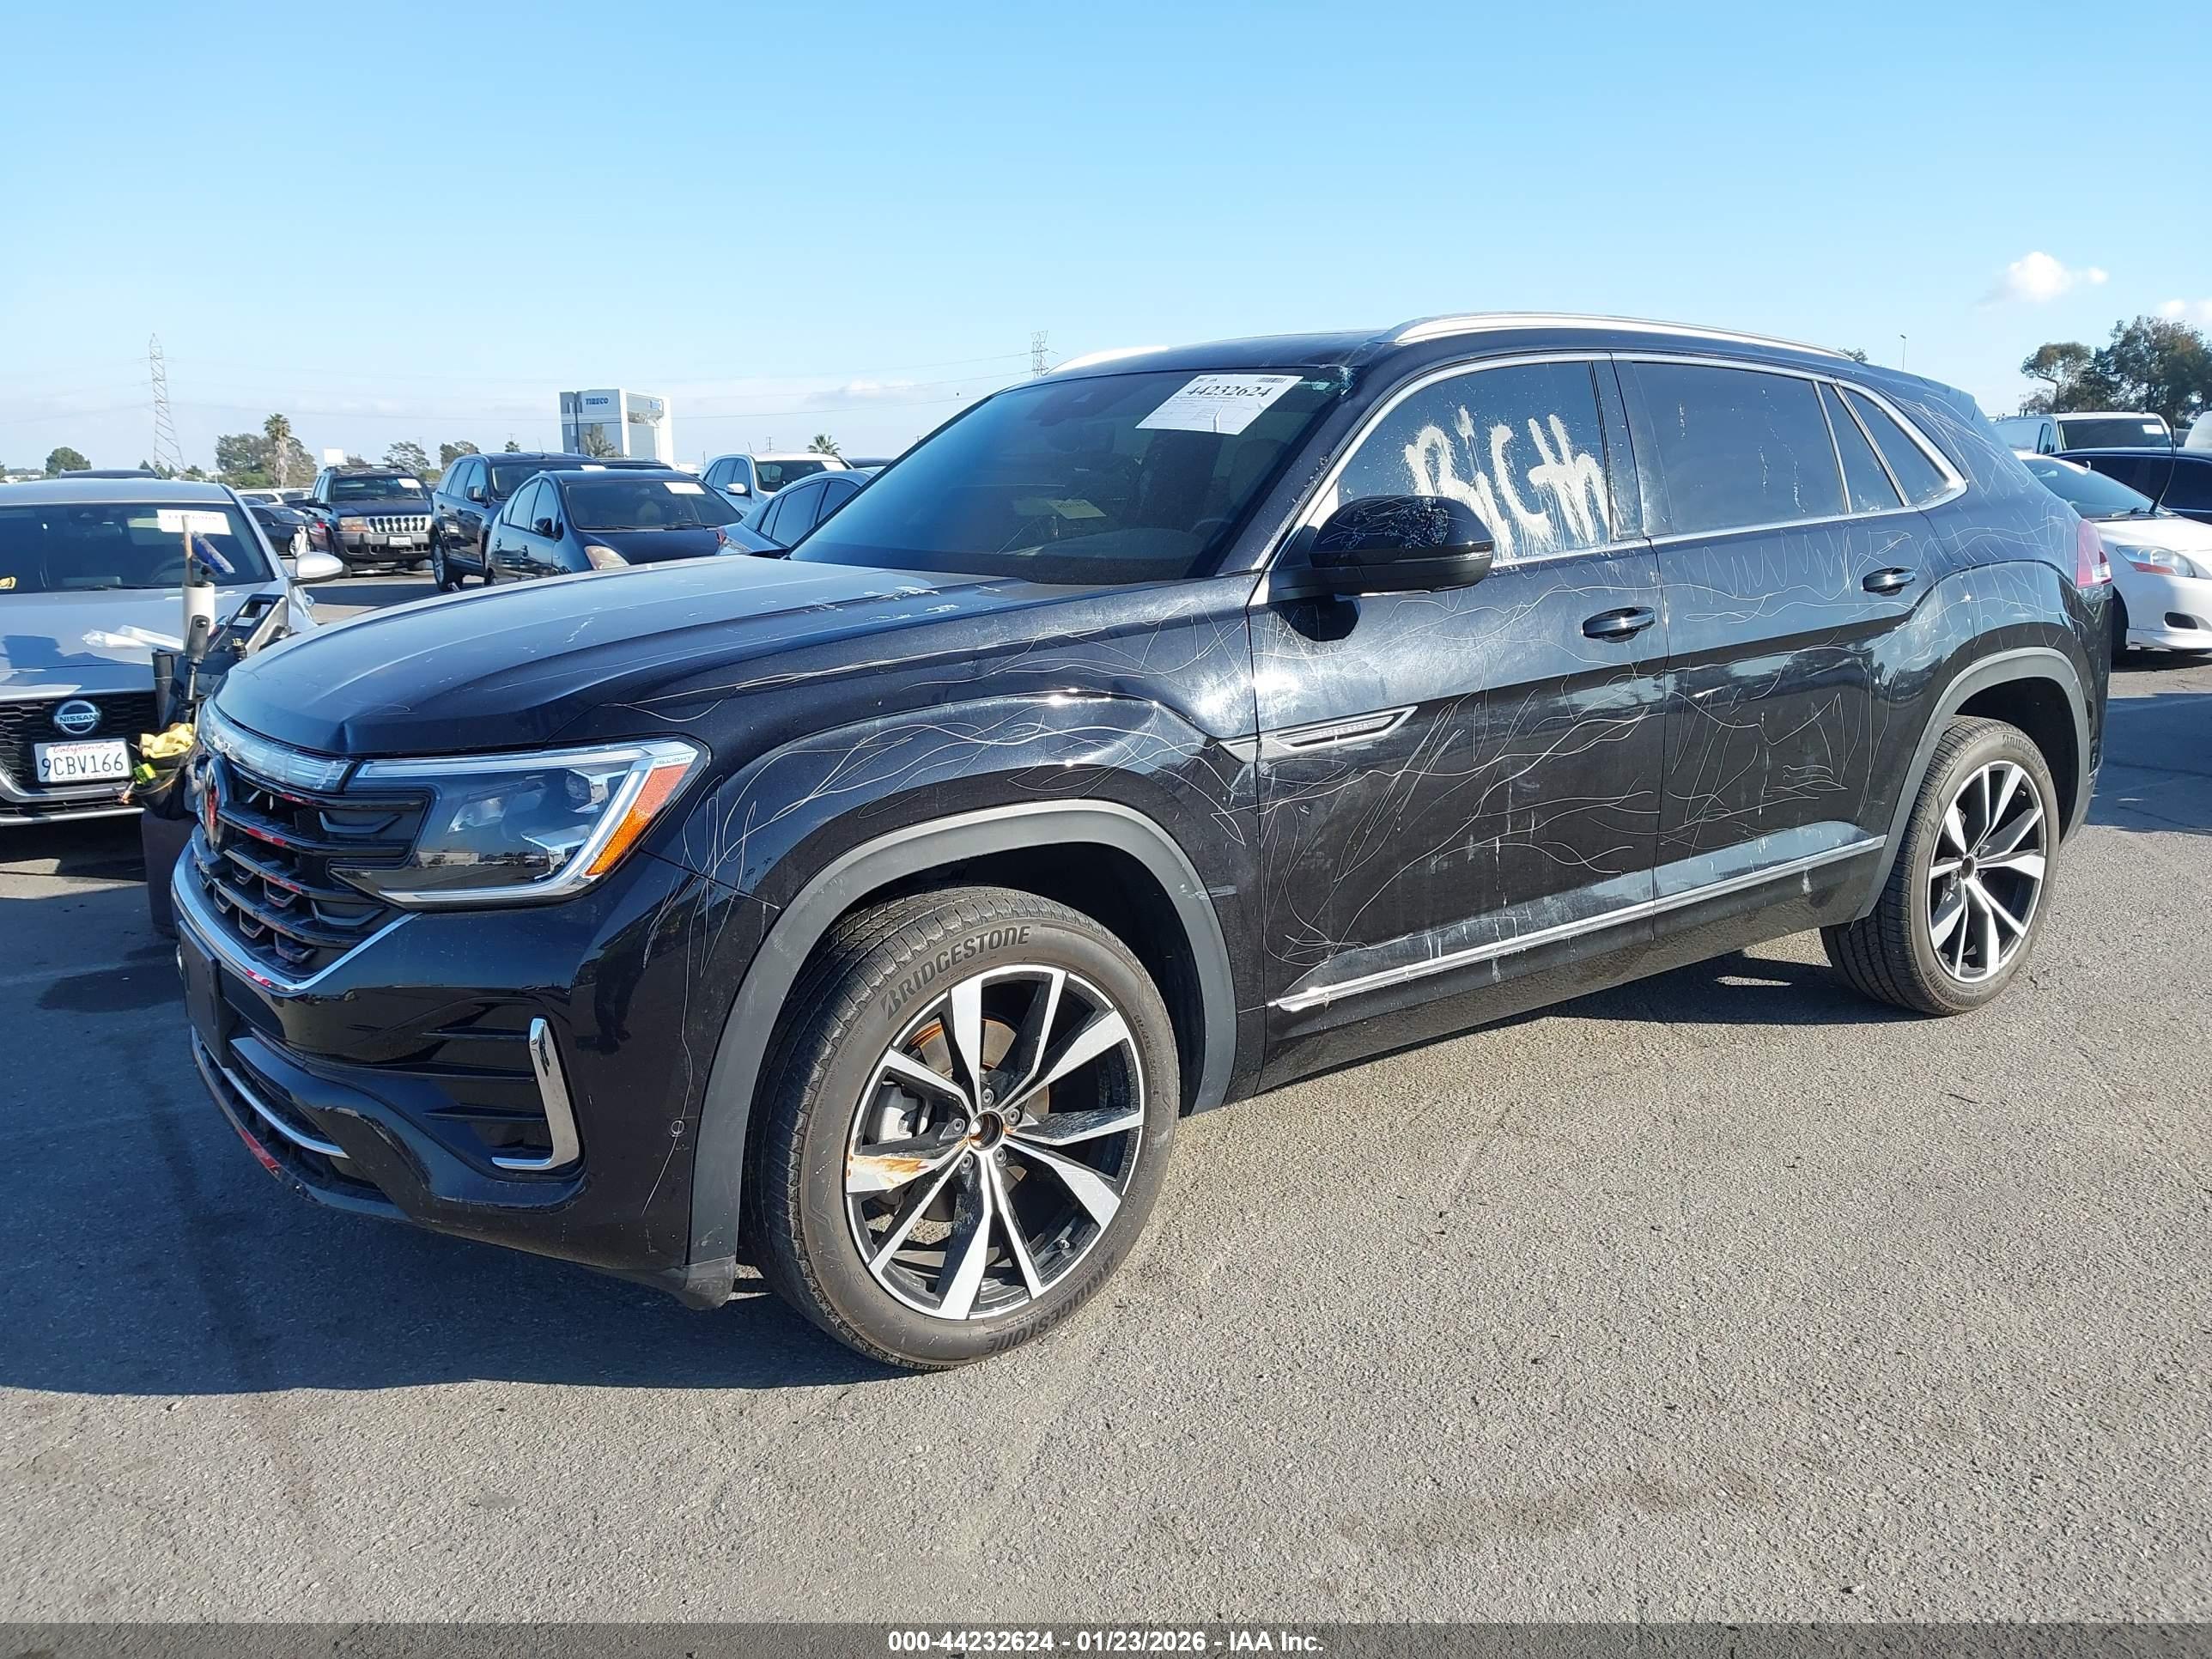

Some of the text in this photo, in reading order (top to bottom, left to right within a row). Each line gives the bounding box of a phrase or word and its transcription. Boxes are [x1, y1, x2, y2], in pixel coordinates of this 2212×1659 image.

[1187, 385, 1274, 398] 44232624
[59, 714, 97, 723] NISSAN
[52, 744, 107, 755] California
[41, 752, 124, 777] 9CBV166
[879, 926, 1031, 1021] BRIDGESTONE
[983, 1252, 1118, 1355] BRIDGESTONE
